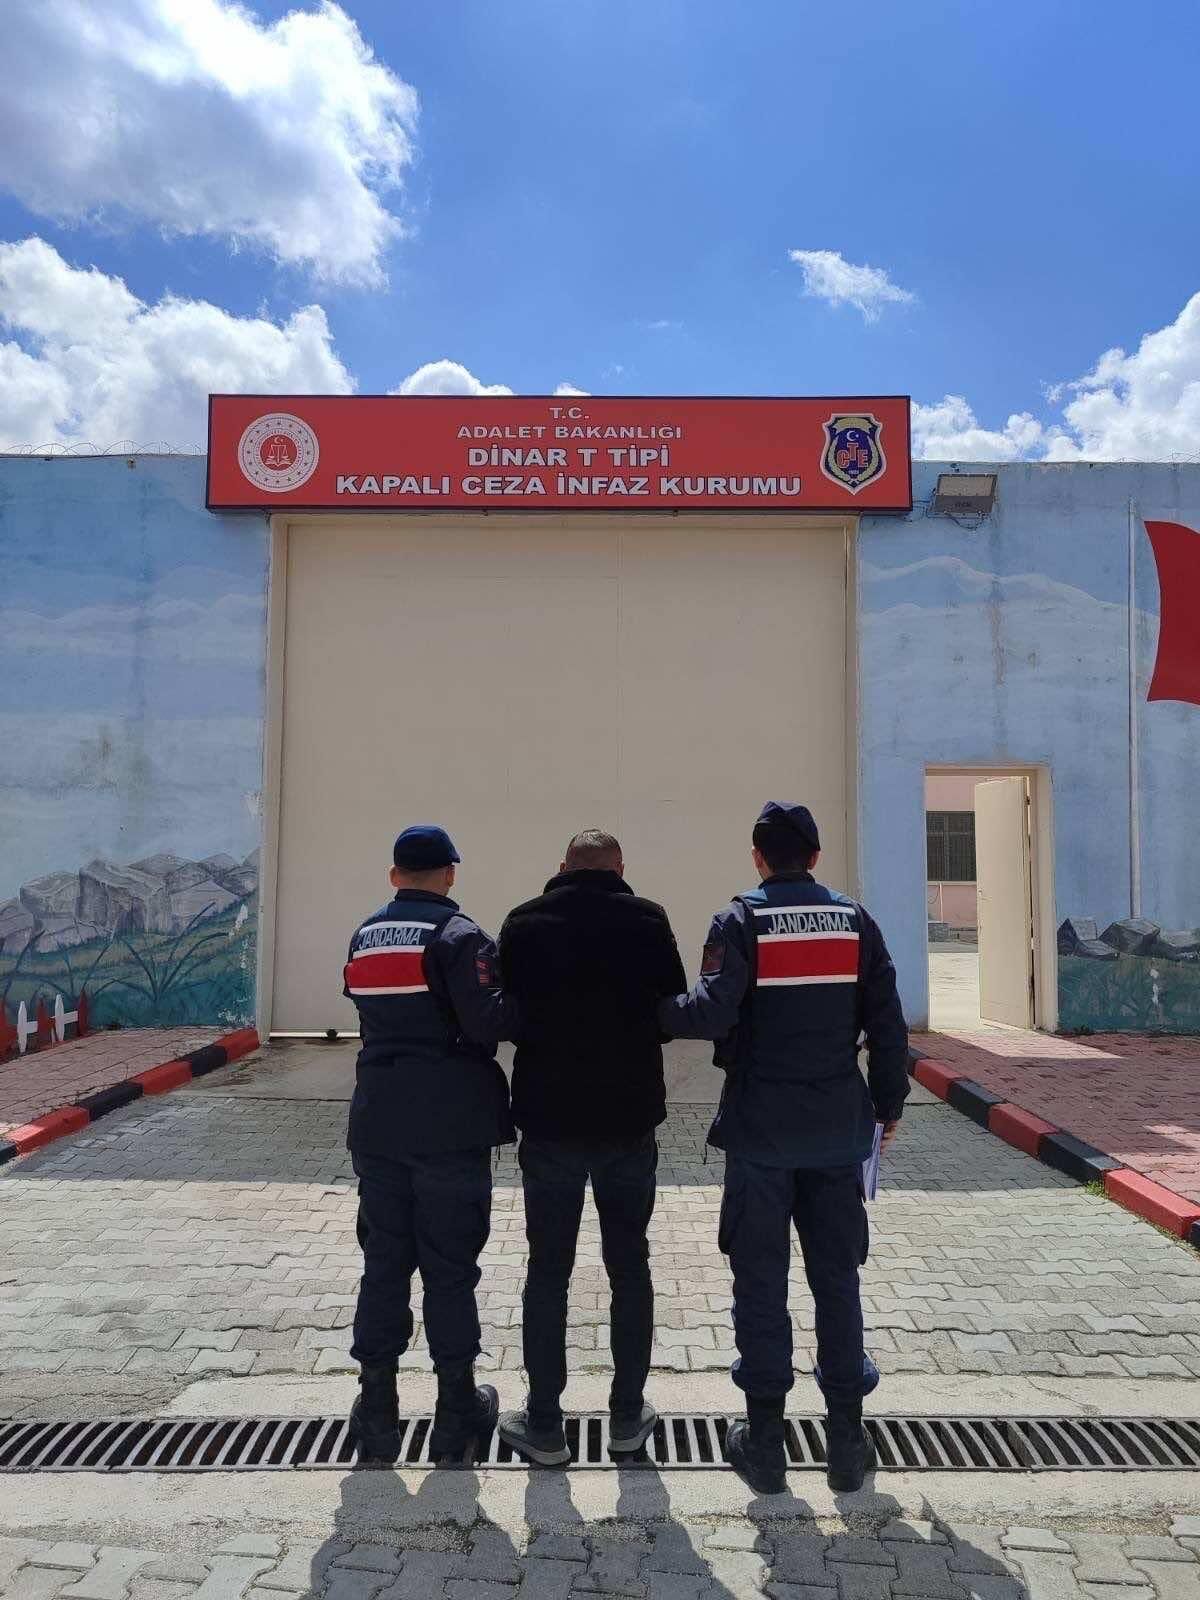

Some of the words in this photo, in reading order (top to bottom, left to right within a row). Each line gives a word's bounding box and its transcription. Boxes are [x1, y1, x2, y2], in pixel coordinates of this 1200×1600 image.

[549, 407, 590, 419] T.C.
[457, 426, 546, 439] ADALET
[555, 424, 682, 439] BAKANLIĞI
[468, 443, 568, 467] DİNAR
[577, 448, 598, 467] T
[607, 443, 671, 467] TİPİ
[336, 475, 450, 495] KAPALI
[461, 476, 547, 495] CEZA
[557, 471, 651, 496] İNFAZ
[660, 476, 802, 496] KURUMU
[768, 912, 851, 934] JANDARMA
[359, 927, 421, 949] JANDARMA
